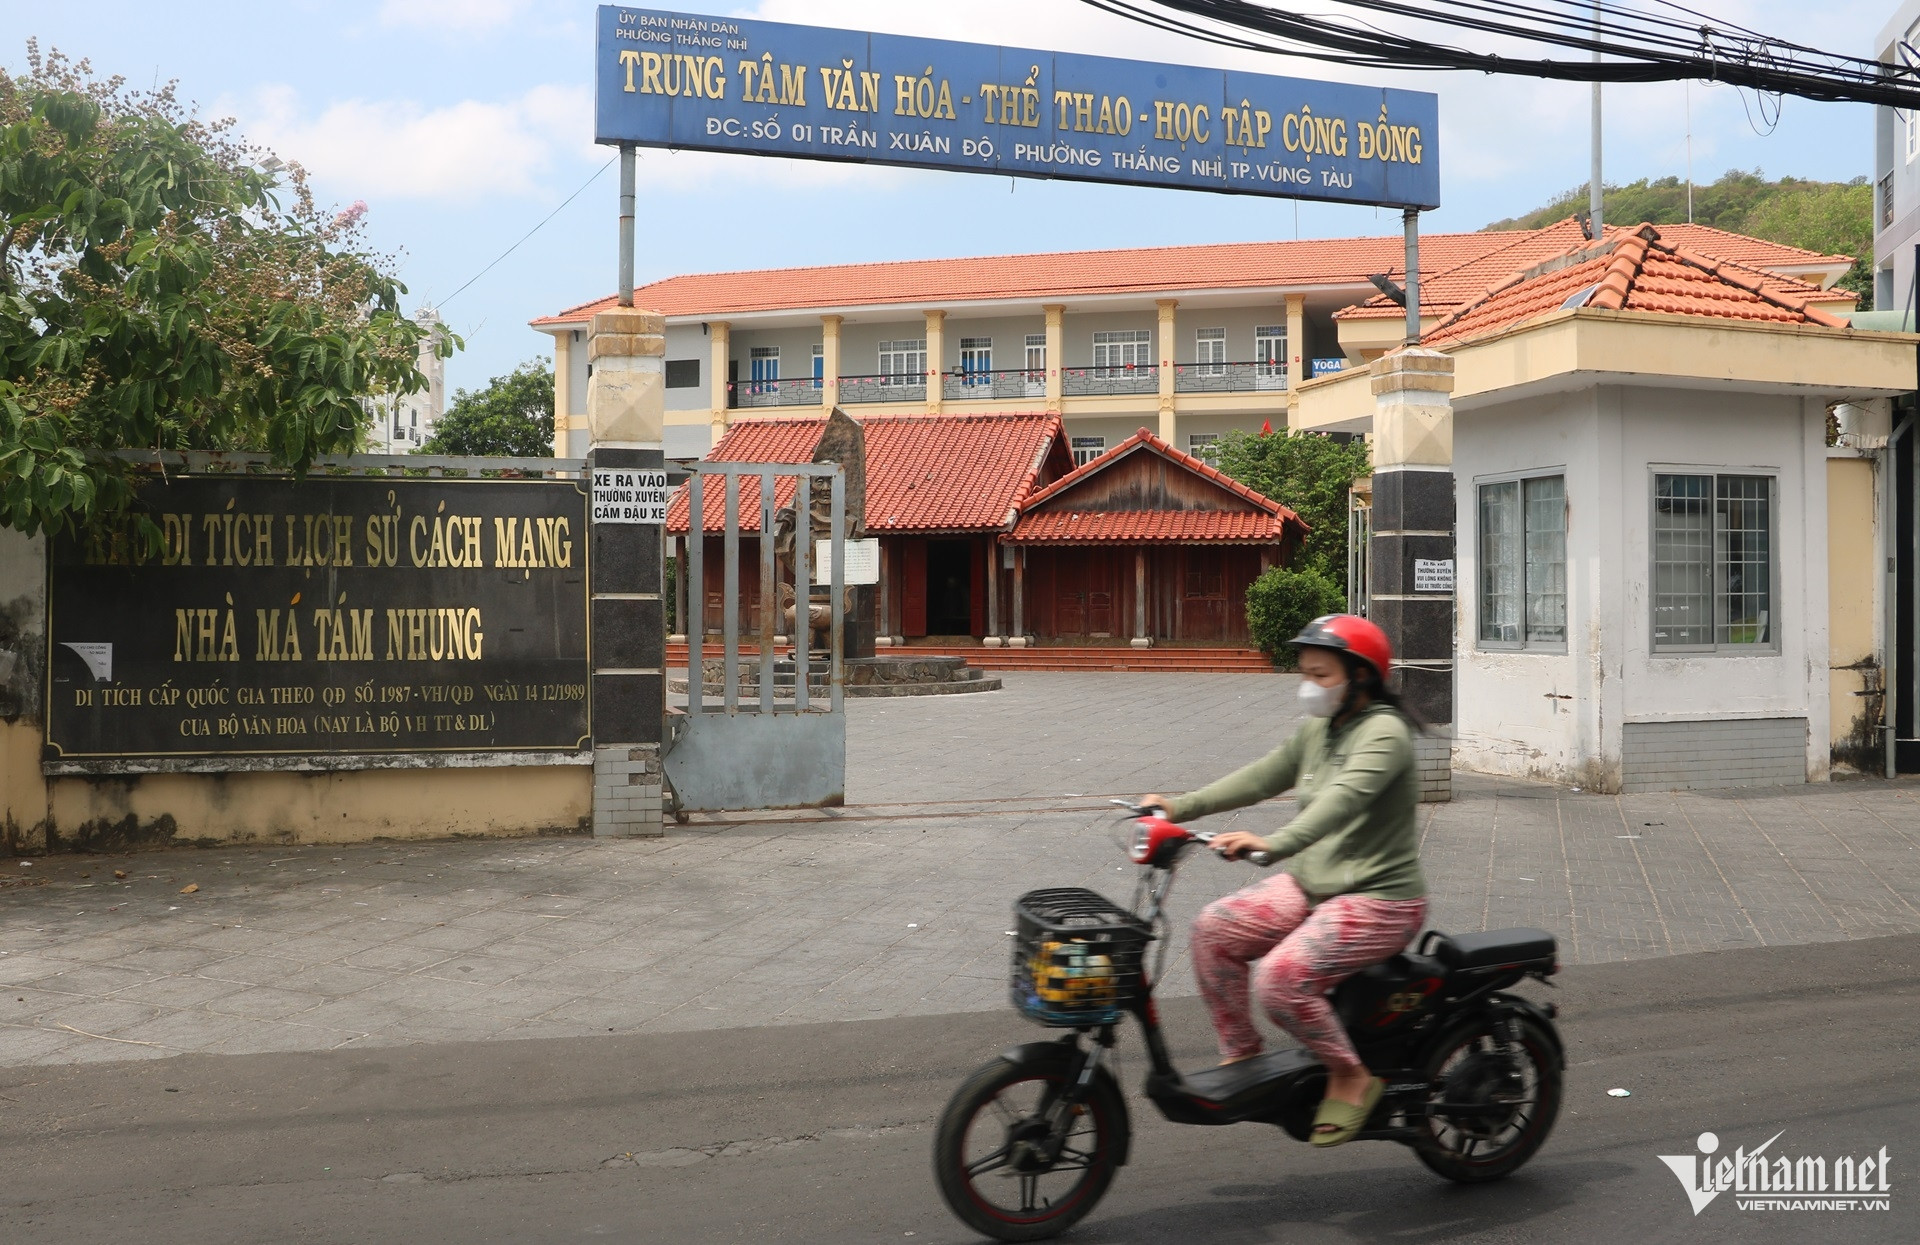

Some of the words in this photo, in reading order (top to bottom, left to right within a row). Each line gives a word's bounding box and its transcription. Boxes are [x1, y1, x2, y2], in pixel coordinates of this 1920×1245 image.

[619, 10, 637, 24] ỦY
[640, 16, 667, 28] BAN
[671, 18, 708, 32] NHÂN
[711, 21, 739, 35] DÂN
[616, 28, 672, 43] PHƯỜNG
[676, 31, 722, 48] THẮNG
[727, 37, 747, 50] NHÌ
[619, 50, 726, 100] TRUNG
[738, 51, 807, 107] TÂM
[820, 58, 881, 113] VĂN
[894, 65, 957, 120] HÓA
[980, 64, 1041, 129] THỂ
[1054, 91, 1132, 136] THAO
[1154, 101, 1210, 152] HỌC
[1221, 98, 1272, 156] TẬP
[1283, 104, 1348, 163] CỘNG
[1358, 103, 1422, 164] ĐỒNG
[792, 124, 812, 142] 01
[820, 120, 877, 148] TRẦN
[889, 130, 950, 154] XUÂN
[1014, 140, 1102, 167] PHƯỜNG
[1112, 148, 1181, 174] THẮNG
[1321, 167, 1353, 189] TÀU
[1313, 361, 1341, 370] YOGA
[594, 474, 611, 487] XE
[616, 474, 633, 487] RA
[638, 472, 665, 487] VÀO
[594, 488, 632, 502] THƯỜNG
[635, 488, 665, 503] XUYÊN
[594, 503, 620, 519] CẤM
[624, 505, 647, 521] ĐẬU
[651, 508, 665, 519] XE
[162, 513, 192, 567] DI
[203, 497, 275, 567] TÍCH
[286, 513, 353, 579] LỊCH
[366, 489, 402, 568] SỬ
[410, 500, 483, 568] CÁCH
[494, 516, 572, 580] MẠNG
[173, 591, 240, 662] NHÀ
[255, 592, 302, 662] MÁ
[313, 592, 374, 662] TÁM
[386, 607, 484, 661] NHUNG
[75, 689, 93, 706] DI
[102, 681, 142, 706] TÍCH
[149, 679, 180, 705] CẤP
[186, 678, 229, 709] QUỐC
[237, 687, 265, 704] GIA
[271, 687, 315, 704] THEO
[322, 687, 346, 707] QĐ
[484, 679, 520, 701] NGÀY
[218, 713, 239, 739] BỘ
[243, 714, 272, 735] VĂN
[314, 714, 350, 734] (NAY
[355, 711, 375, 733] LÀ
[379, 711, 400, 737] BỘ
